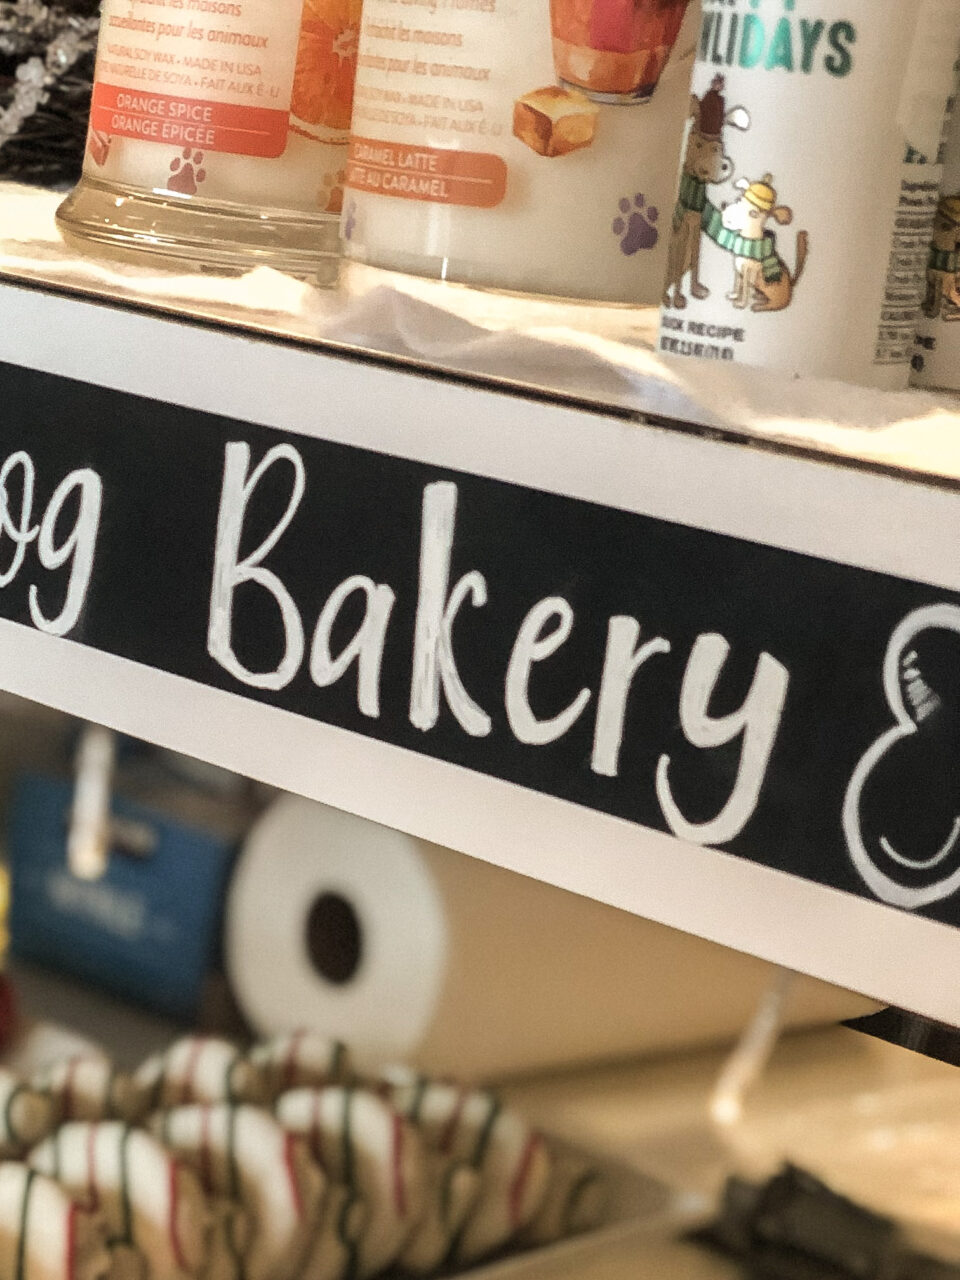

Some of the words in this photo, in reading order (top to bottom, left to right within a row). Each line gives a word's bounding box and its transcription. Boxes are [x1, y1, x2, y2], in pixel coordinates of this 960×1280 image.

[207, 25, 269, 48] animaux
[236, 62, 262, 77] USA
[116, 93, 165, 116] ORANGE
[168, 101, 213, 122] SPICE
[111, 114, 159, 137] ORANGE
[398, 150, 439, 171] LATTE
[382, 173, 449, 198] CARAMEL
[206, 441, 790, 846] Bakery
